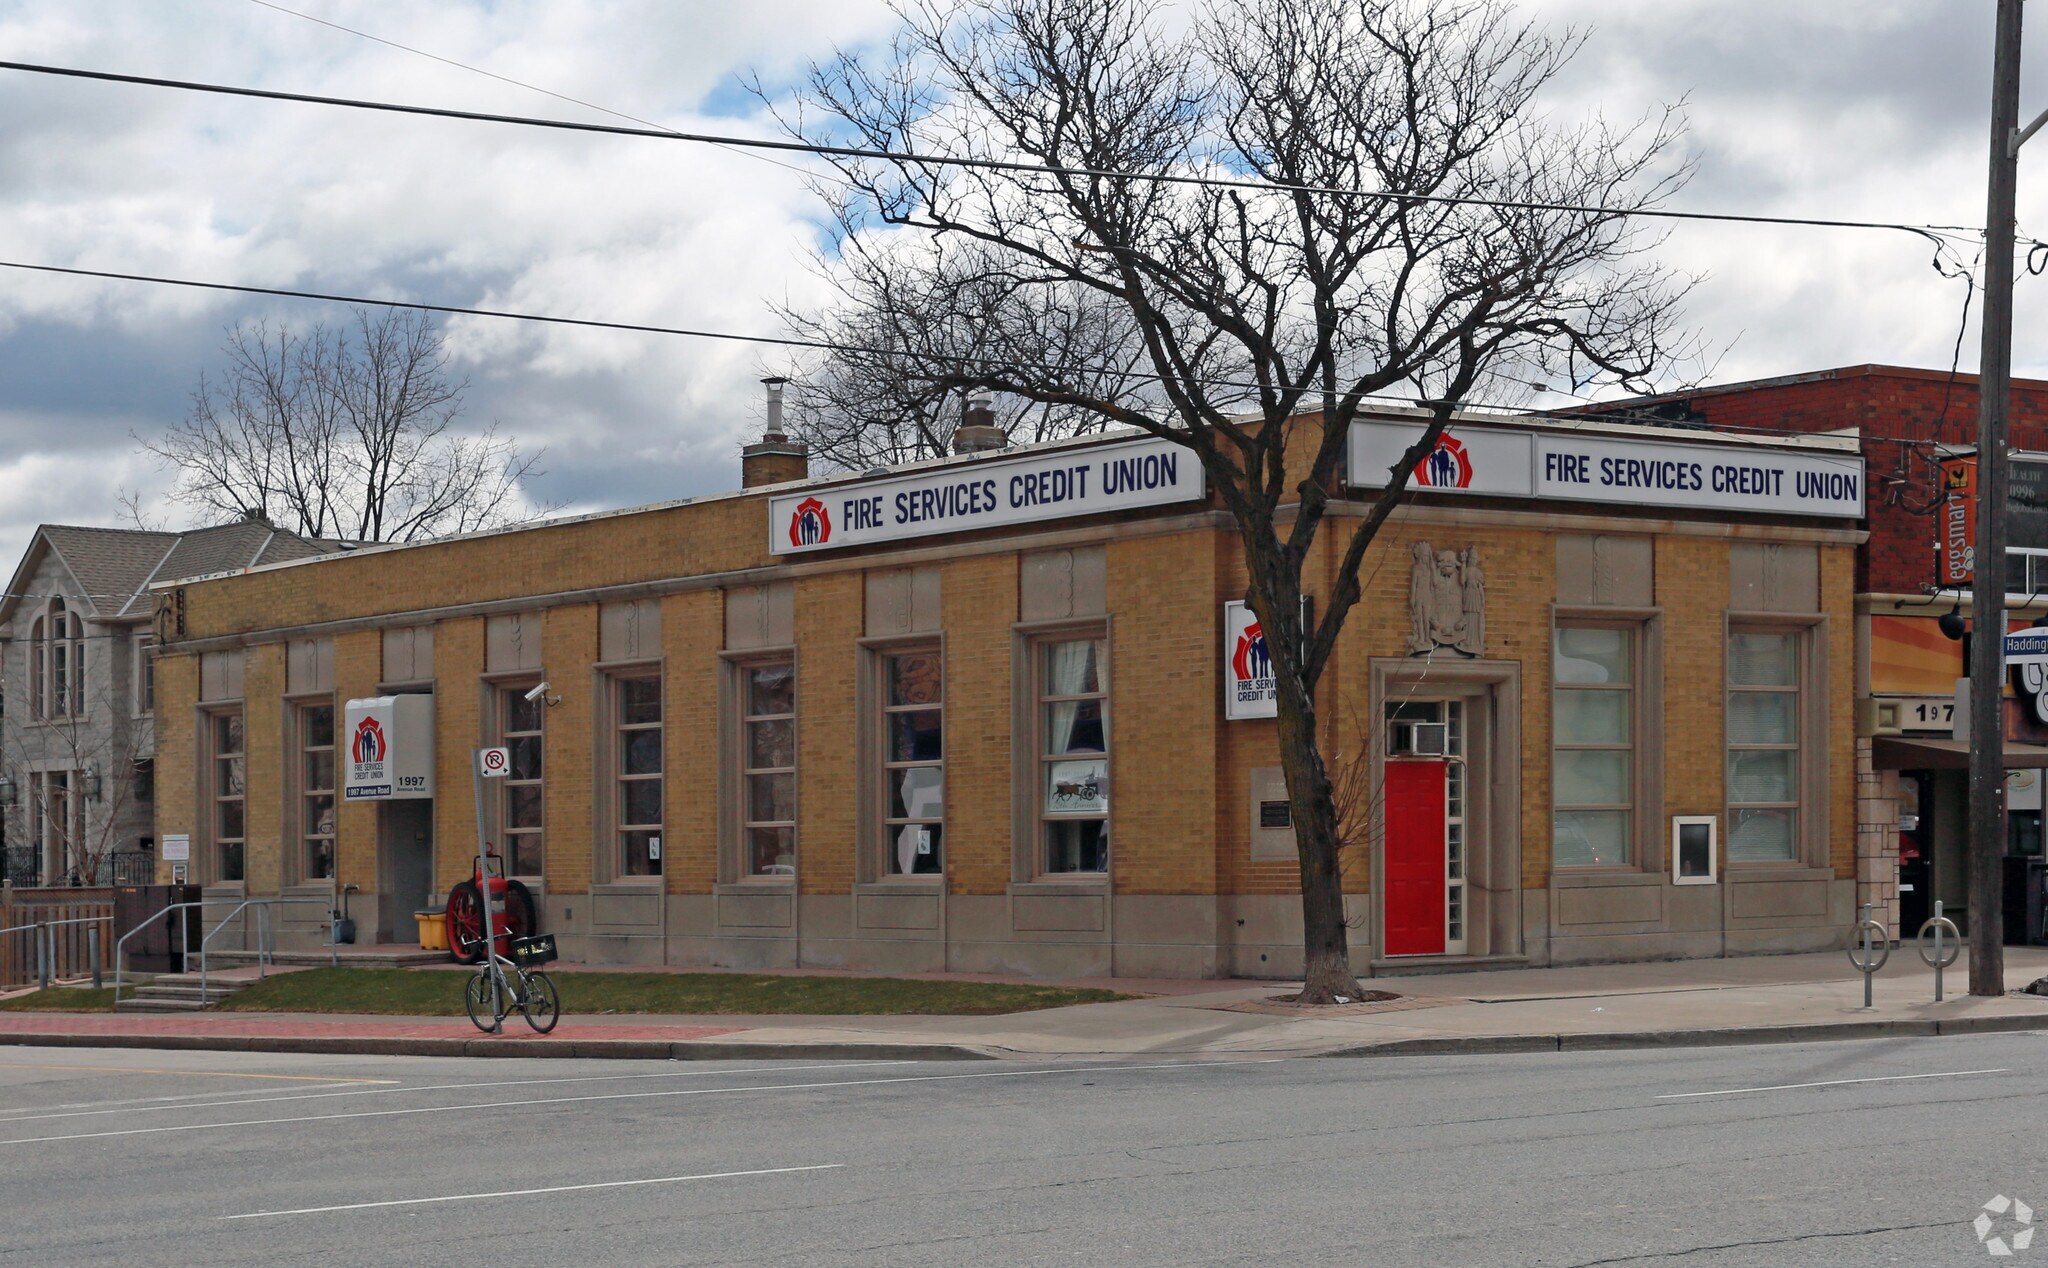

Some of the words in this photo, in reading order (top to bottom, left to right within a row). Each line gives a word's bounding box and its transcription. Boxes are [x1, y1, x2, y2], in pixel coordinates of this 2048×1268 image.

[1546, 453, 1590, 483] FIRE
[1600, 457, 1703, 491] SERVICES
[1712, 465, 1784, 496] CREDIT
[1796, 471, 1857, 501] UNION
[844, 496, 883, 531] FIRE
[895, 479, 996, 524] SERVICES
[1010, 465, 1090, 508] CREDIT
[1103, 452, 1177, 495] UNION
[1947, 492, 1974, 580] eggsmart
[2007, 637, 2048, 653] Hadding
[1238, 681, 1253, 690] FIRE
[1238, 691, 1263, 702] CREDIT
[354, 764, 363, 772] FIRE
[364, 763, 384, 771] SERVICES
[354, 772, 369, 780] CREDIT
[370, 771, 384, 780] UNION
[398, 776, 425, 786] 1997
[347, 788, 360, 796] 1997
[360, 787, 377, 796] Avenue
[377, 786, 390, 795] Road
